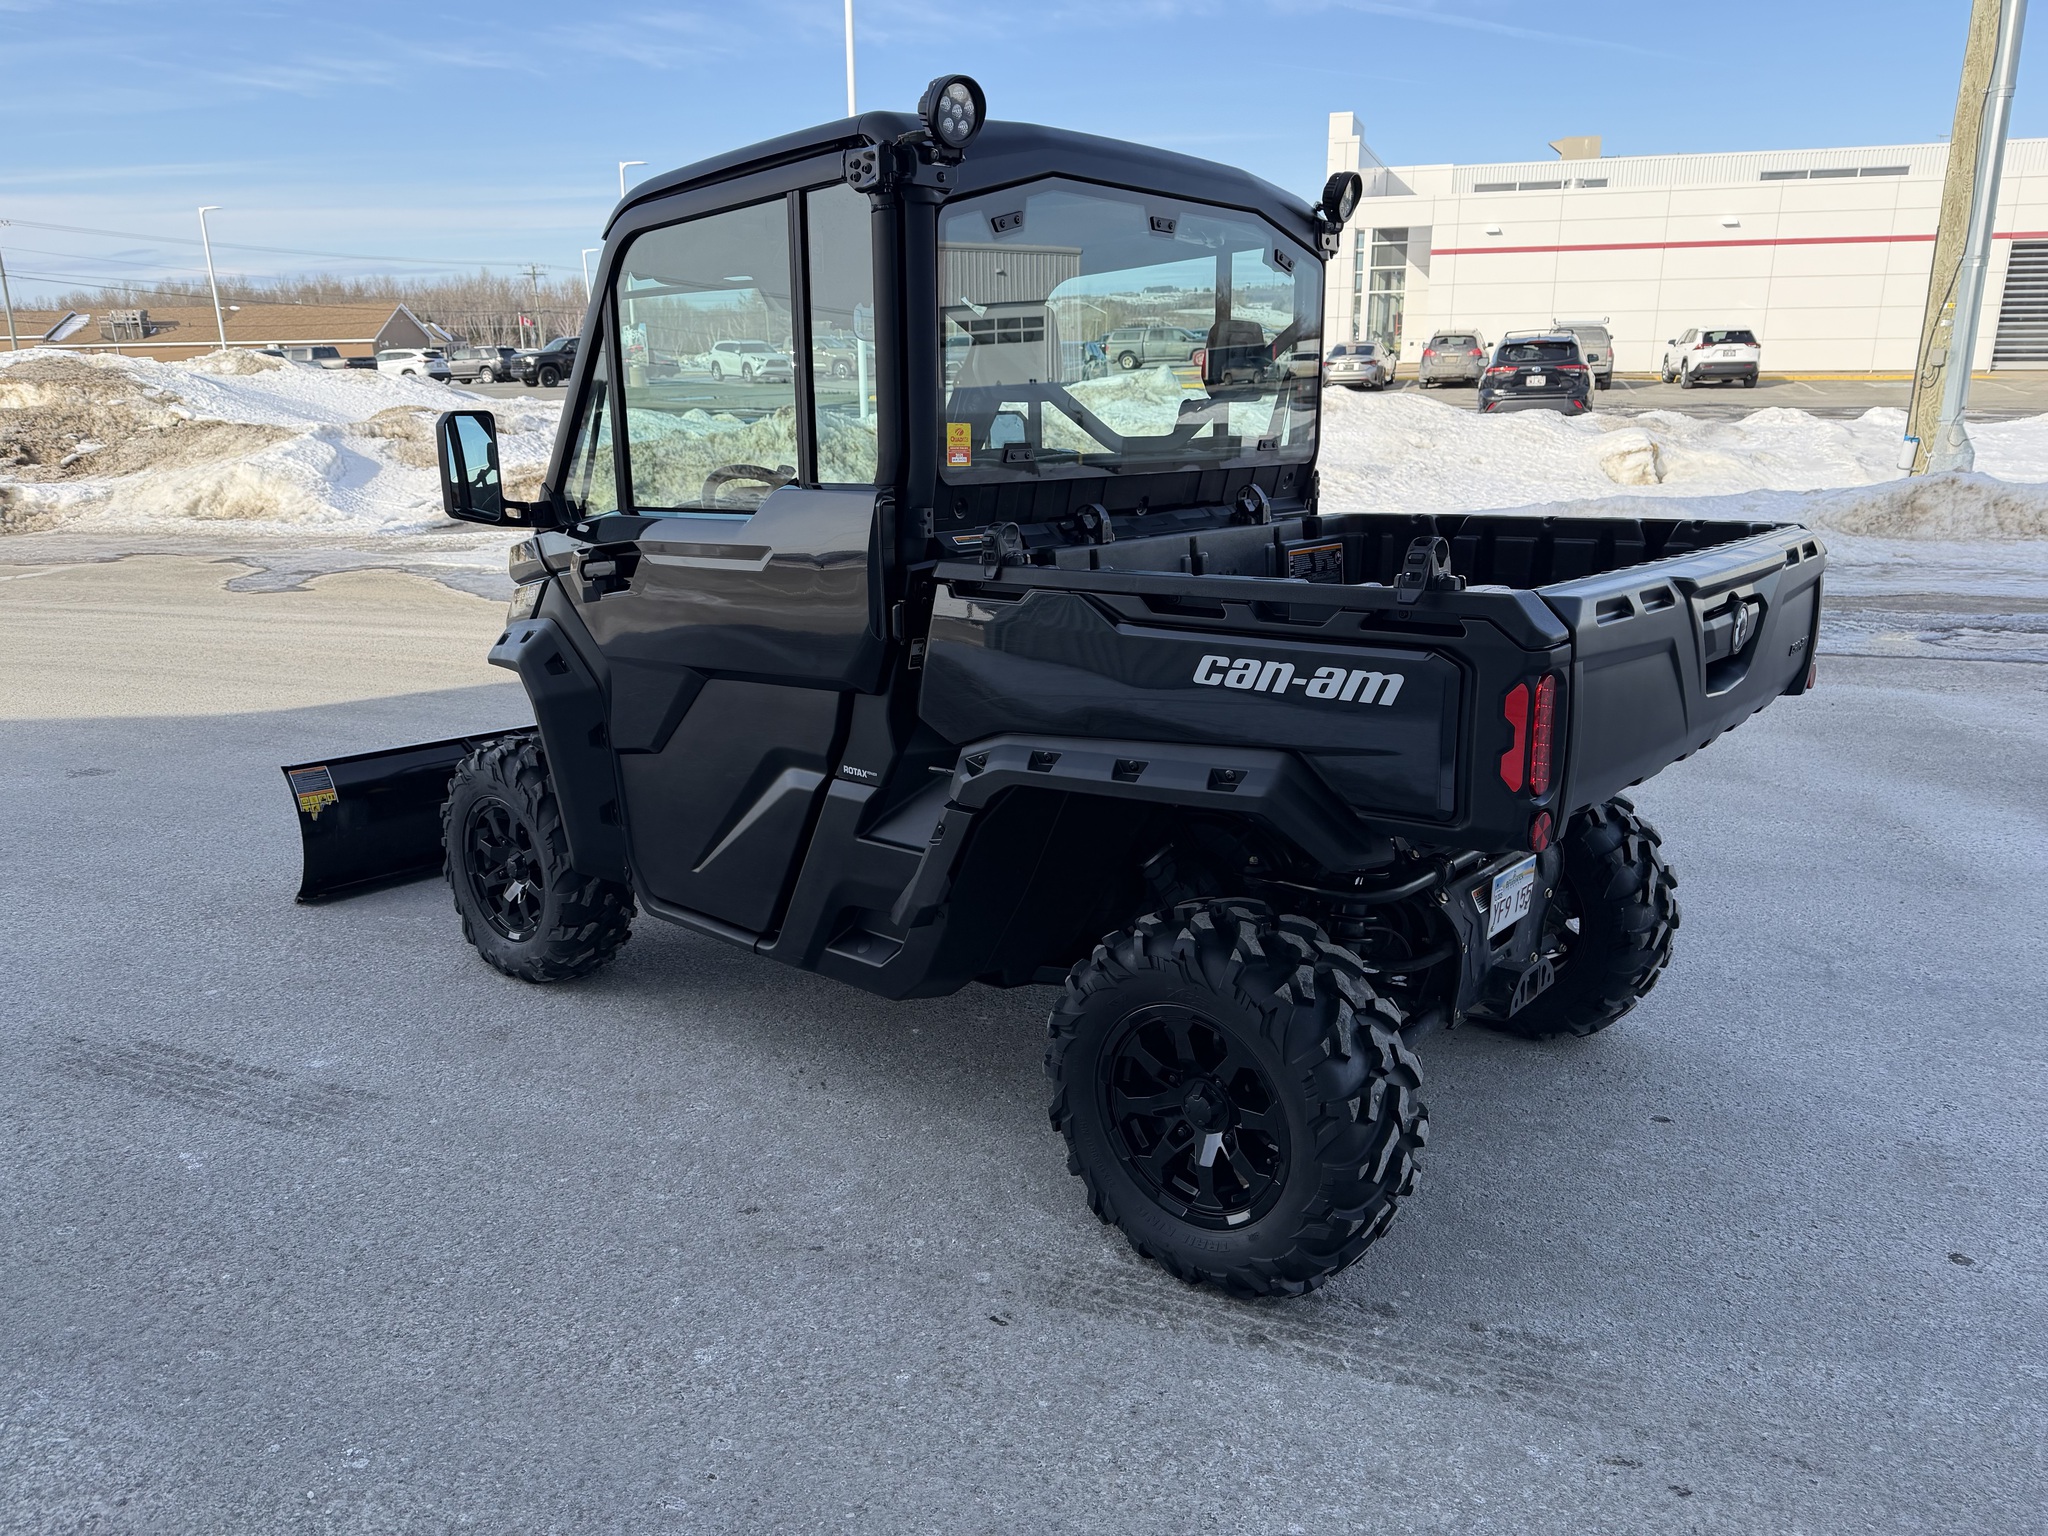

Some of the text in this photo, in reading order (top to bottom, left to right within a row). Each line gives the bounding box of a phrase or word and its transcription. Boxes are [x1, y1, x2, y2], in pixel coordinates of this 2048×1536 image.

[1192, 654, 1405, 707] can-am
[843, 764, 868, 779] ROTAX
[1492, 895, 1512, 926] YF9
[1514, 883, 1534, 913] 155
